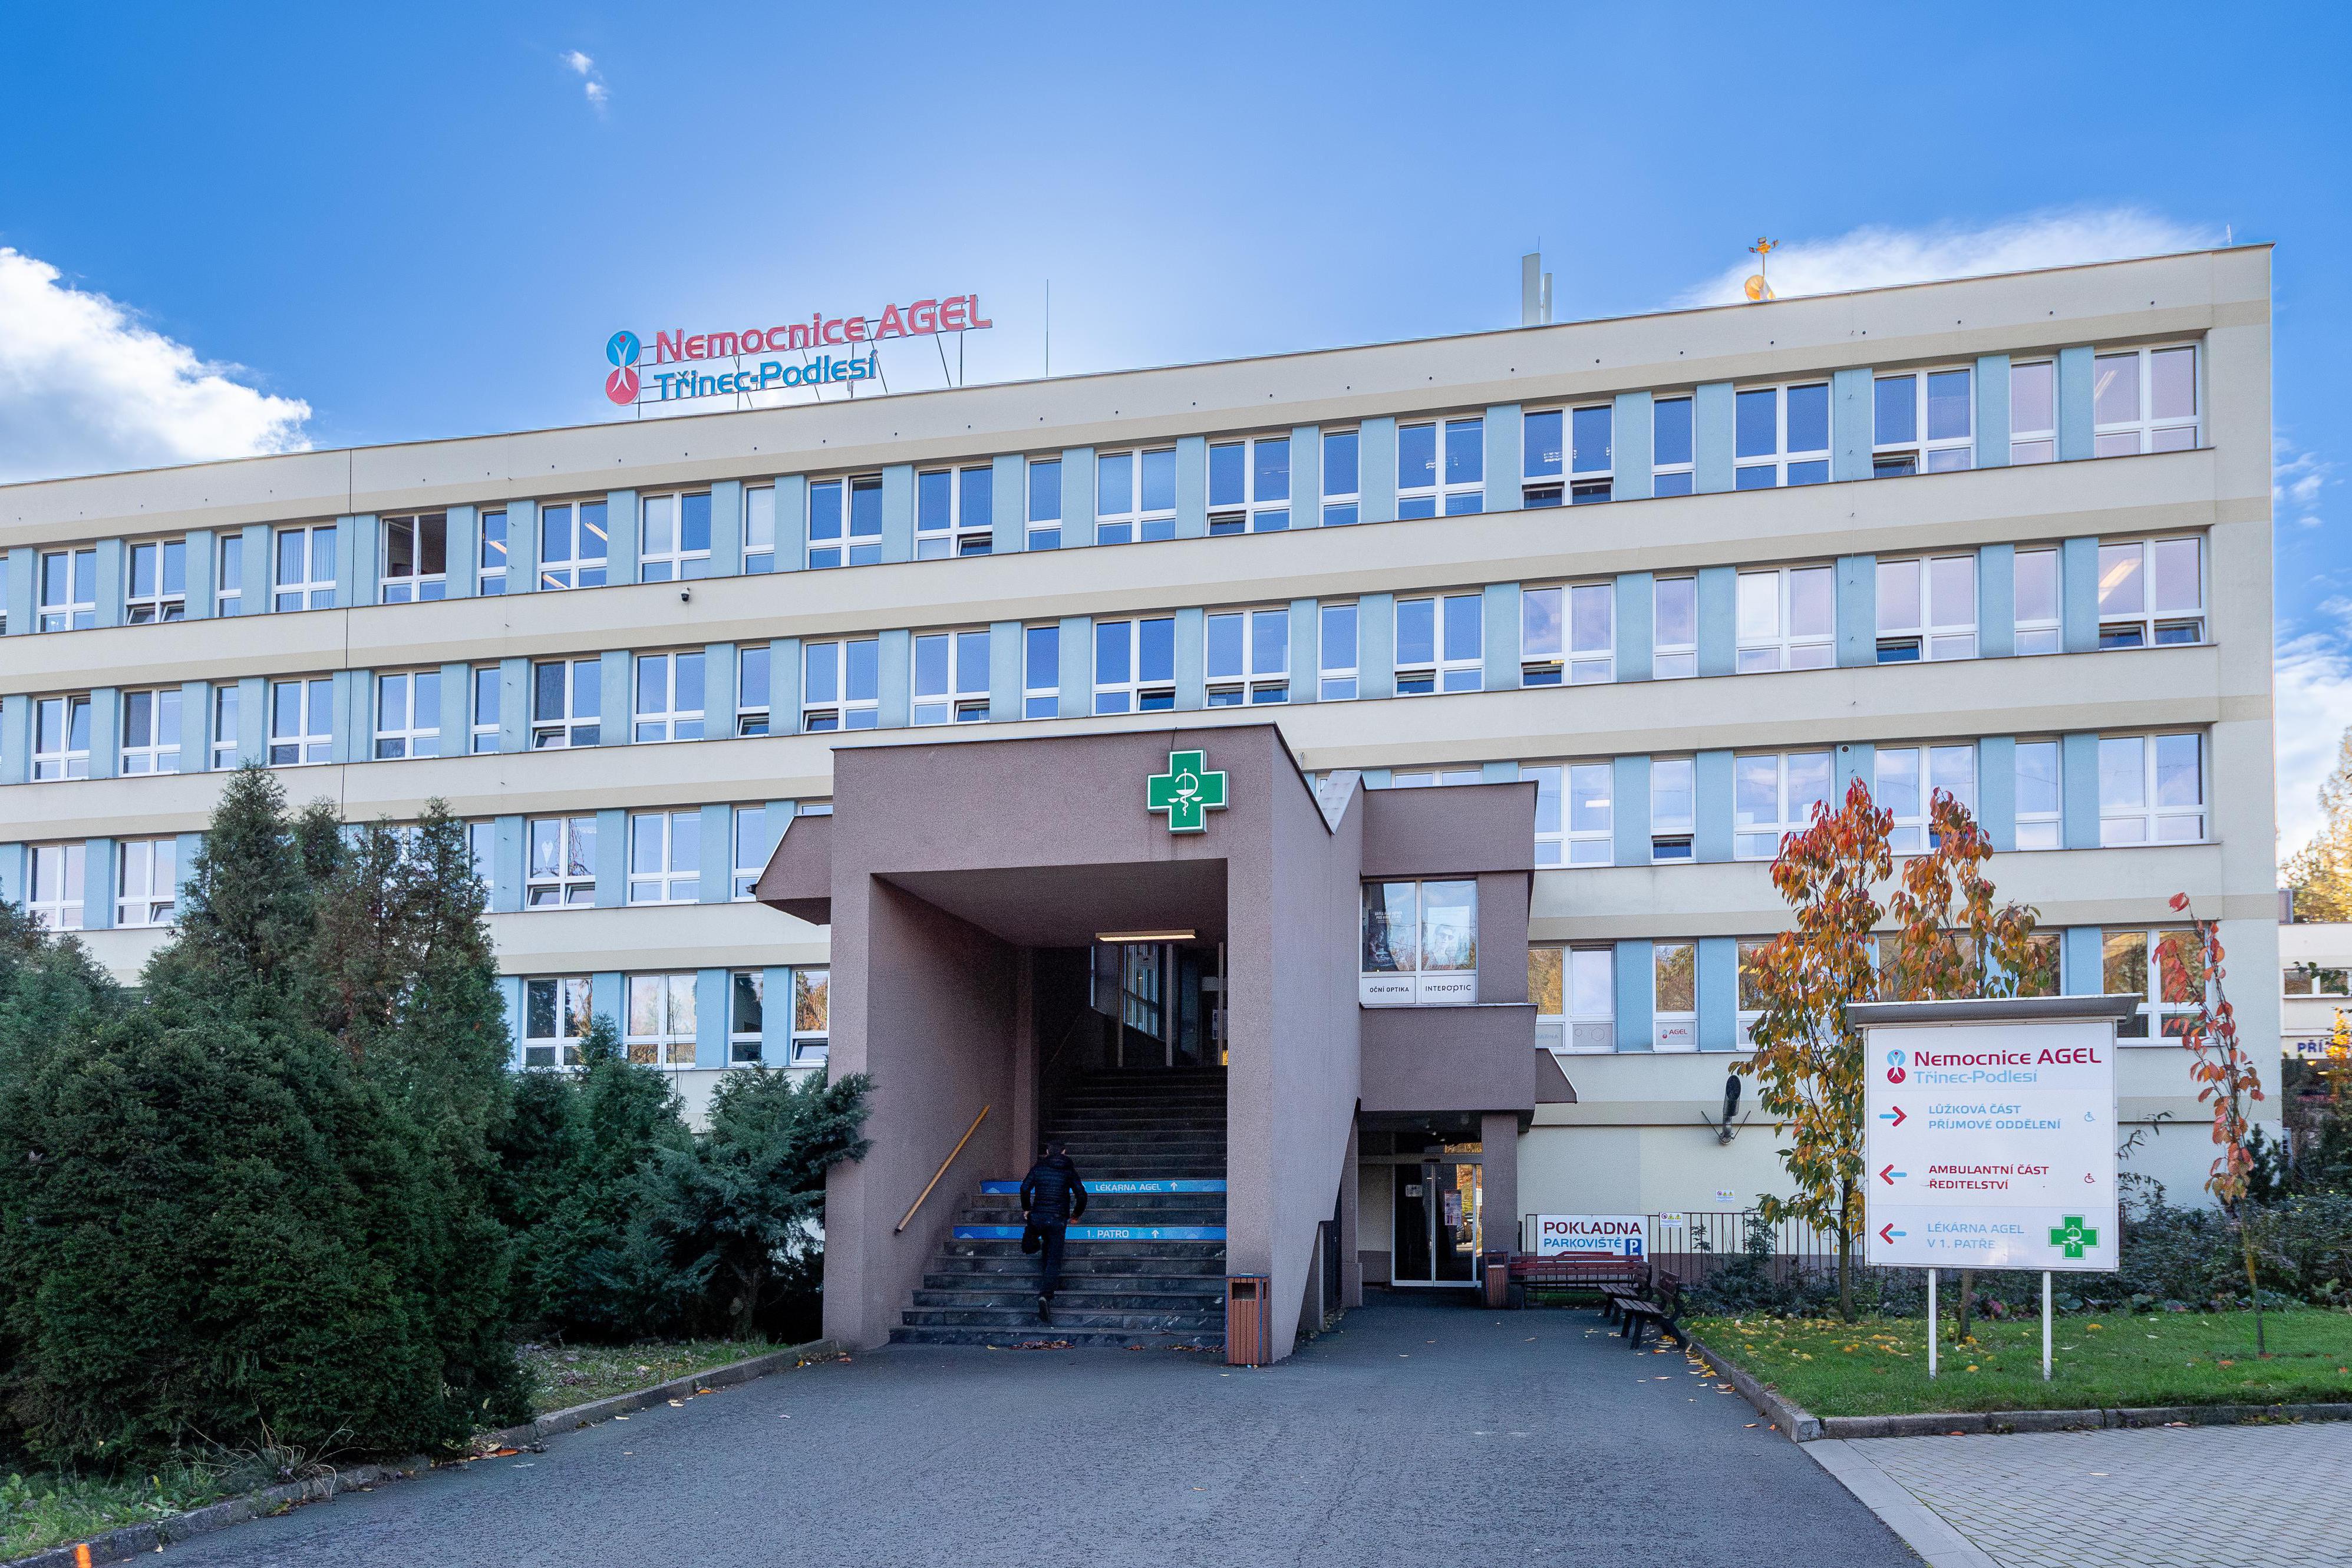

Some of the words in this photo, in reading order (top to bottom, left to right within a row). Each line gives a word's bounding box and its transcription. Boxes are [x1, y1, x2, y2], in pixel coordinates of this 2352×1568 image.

[657, 312, 866, 364] Nemocnice
[874, 293, 992, 341] AGEL
[654, 349, 878, 401] Třinec-Podlesí
[2297, 1039, 2323, 1052] PŘÍ
[1915, 1049, 2031, 1067] Nemocnice
[2037, 1048, 2102, 1064] AGEL
[1914, 1069, 2038, 1084] Třinec-Podlesí
[1929, 1103, 1987, 1114] LŮŽKOVÁ
[1990, 1103, 2021, 1114] ČÁST
[1929, 1118, 1992, 1129] PŘÍJMOVÉ
[1995, 1118, 2061, 1129] ODDĚLENÍ
[1929, 1164, 2014, 1174] AMBULANTNÍ
[2017, 1164, 2049, 1175] ČÁST
[1929, 1179, 2008, 1189] ŘEDITELSTVÍ
[1086, 1229, 1094, 1238] 1.
[1097, 1229, 1130, 1238] PATRO
[1544, 1222, 1642, 1234] POKLADNA
[1928, 1222, 1987, 1233] LÉKÁRNA
[1991, 1224, 2024, 1234] AGEL
[1544, 1237, 1622, 1248] PARKOVIŠTĚ
[1629, 1239, 1638, 1255] P
[1927, 1239, 1936, 1248] V
[1939, 1239, 1950, 1249] 1.
[1954, 1238, 1996, 1249] PATŘE
